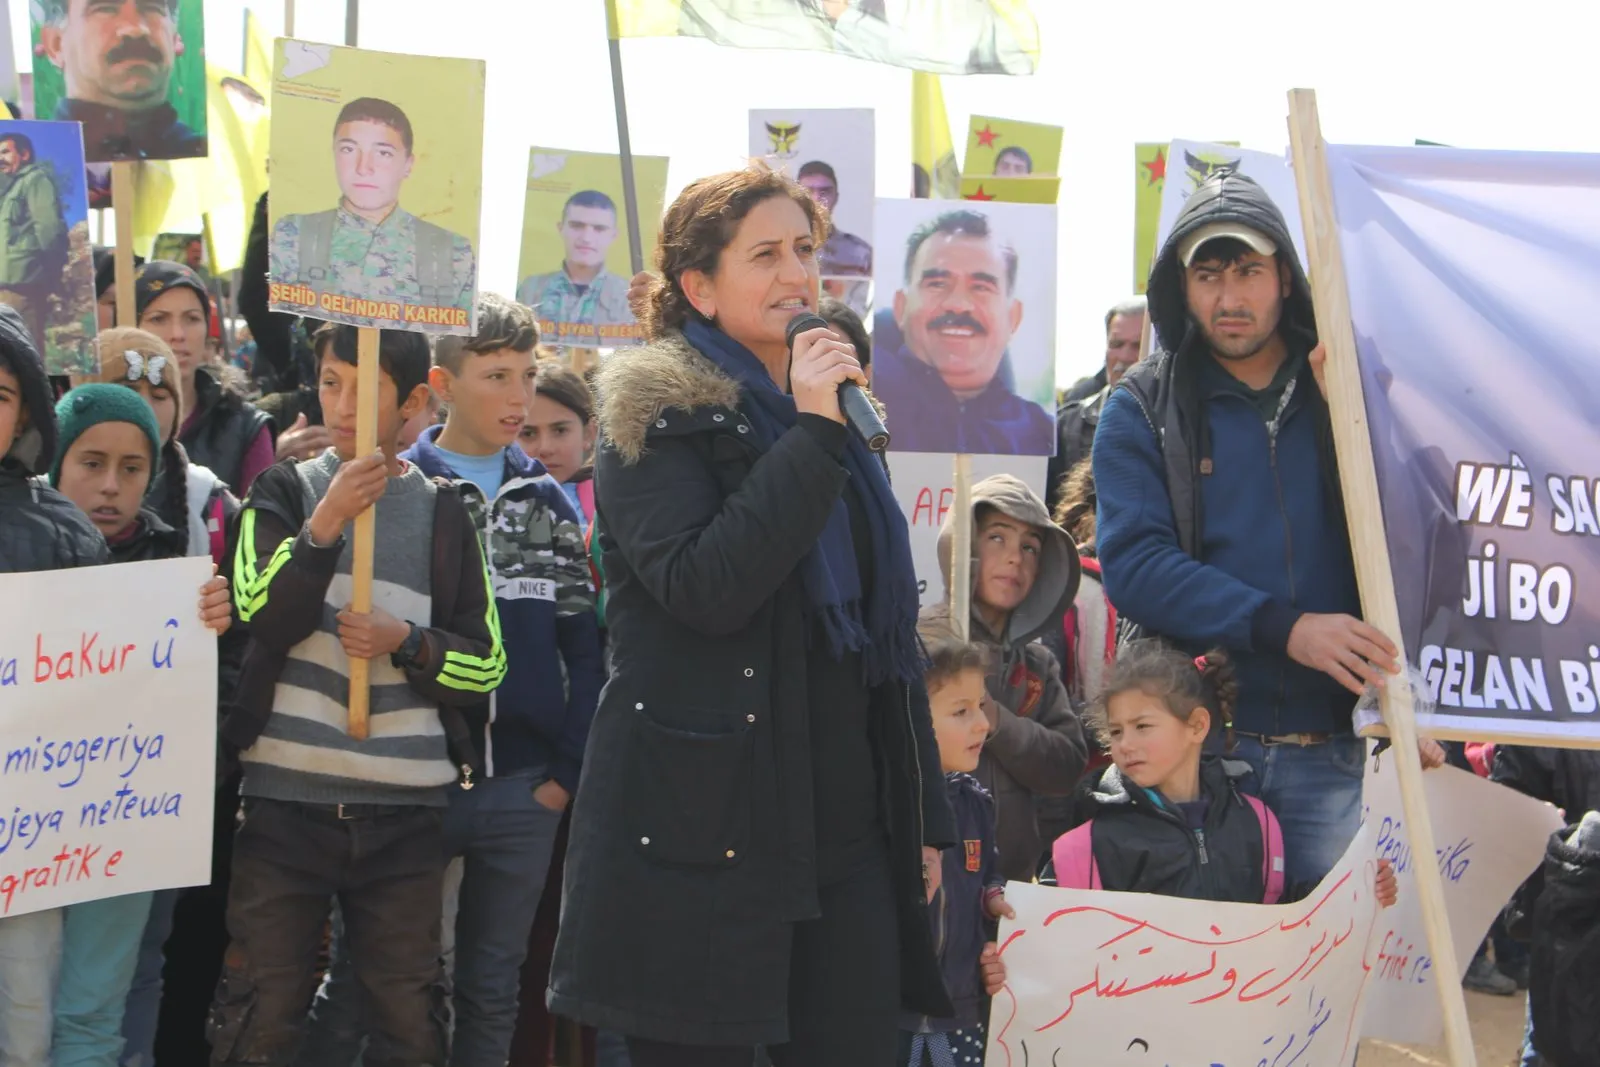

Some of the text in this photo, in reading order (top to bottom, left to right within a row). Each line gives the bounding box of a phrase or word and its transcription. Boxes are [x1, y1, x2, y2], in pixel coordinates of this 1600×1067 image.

[404, 304, 469, 327] KARKIR
[1455, 451, 1600, 537] WÊ SA
[519, 581, 547, 596] NIKE
[1509, 562, 1572, 626] BO
[1420, 643, 1553, 713] GELAN
[4, 722, 165, 788] misogeriya
[79, 782, 183, 829] netewa
